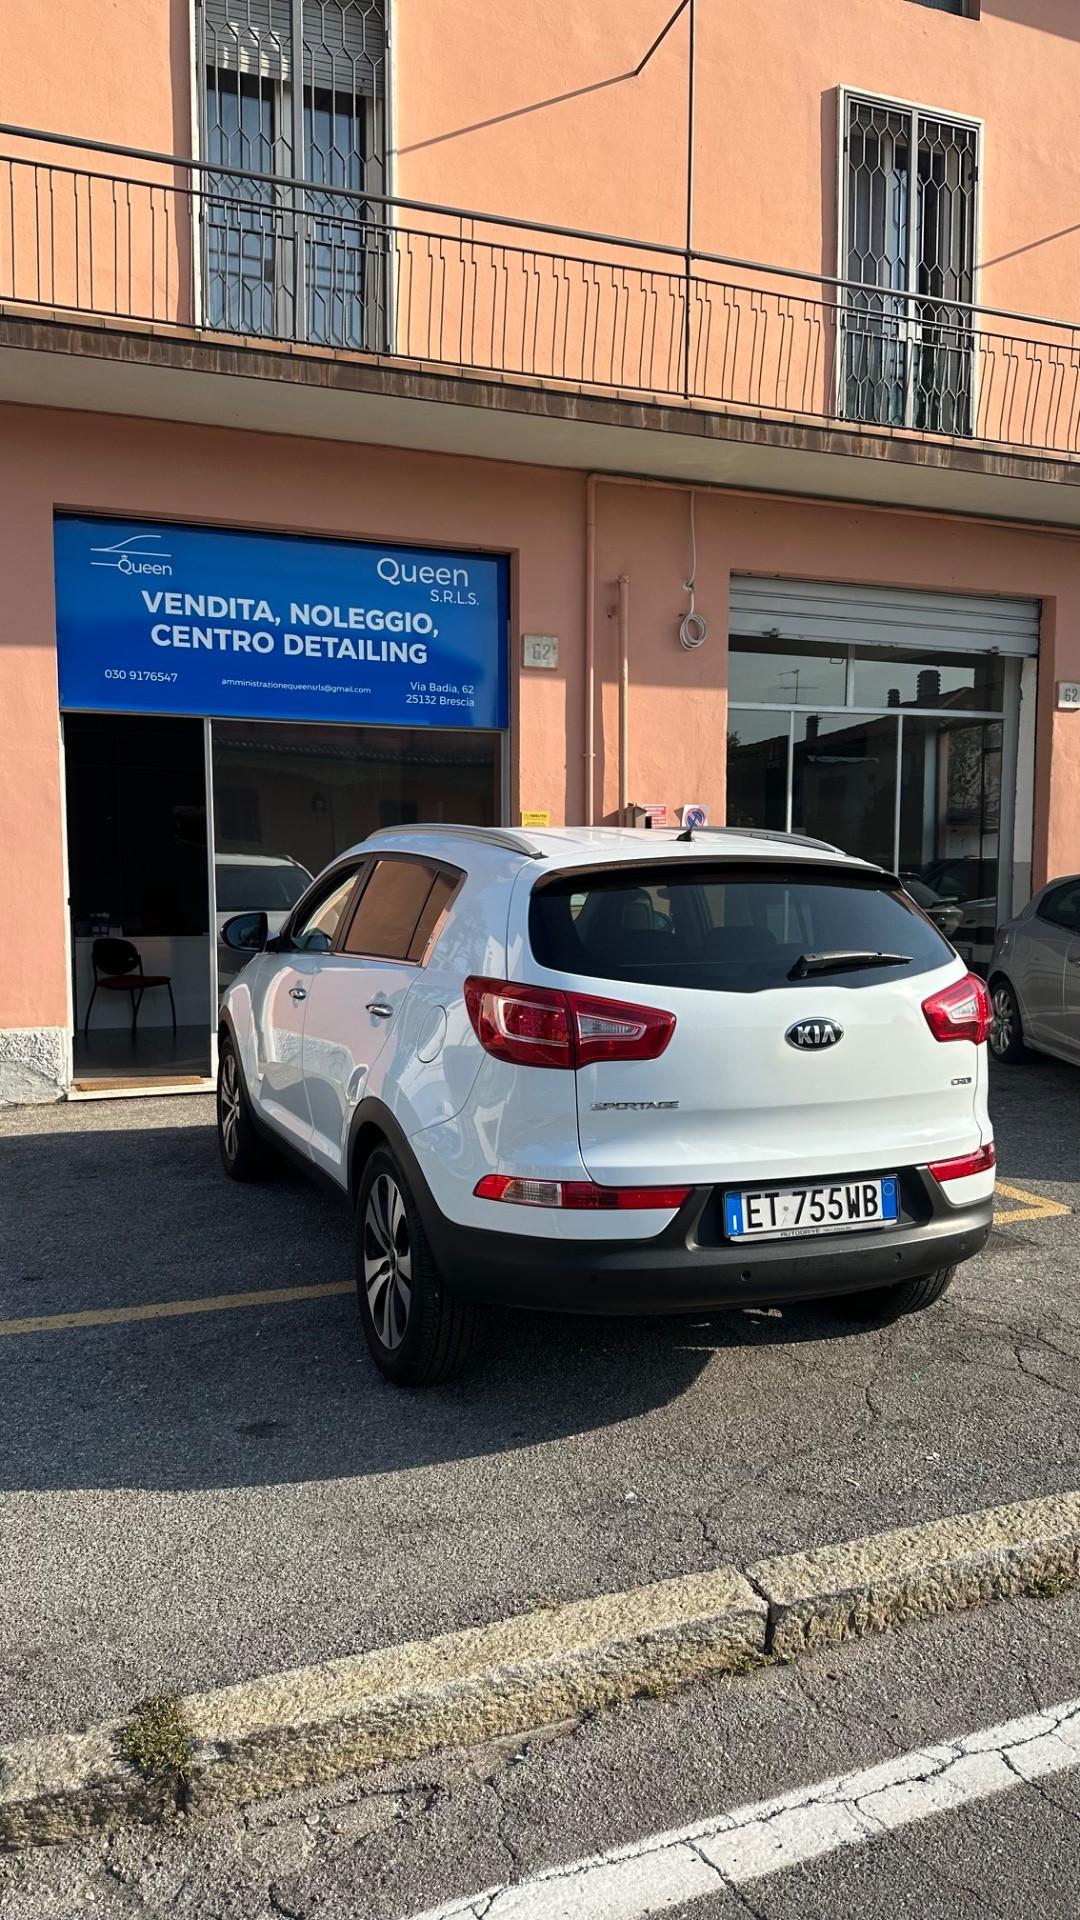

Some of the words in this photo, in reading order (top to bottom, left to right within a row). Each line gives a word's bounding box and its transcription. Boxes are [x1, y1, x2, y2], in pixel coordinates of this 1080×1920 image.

[118, 558, 173, 576] Queen
[376, 557, 469, 588] Queen
[430, 589, 480, 606] S.R.L.S.
[141, 590, 281, 627] VENDITA,
[290, 602, 439, 638] NOLEGGIO,
[151, 623, 275, 654] CENTRO
[283, 633, 428, 665] DETAILING
[104, 669, 127, 680] 030
[129, 670, 178, 683] 9176547
[221, 678, 372, 694] amministrazionequeensrls@gmail.com
[410, 681, 426, 692] Via
[429, 682, 460, 695] Badia,
[462, 685, 475, 694] 62
[406, 694, 437, 705] 25132
[440, 696, 475, 707] Brescia
[797, 1024, 836, 1044] KIA
[590, 1101, 680, 1111] SPORTAGE
[745, 1192, 780, 1229] ET
[792, 1184, 879, 1225] 755WB
